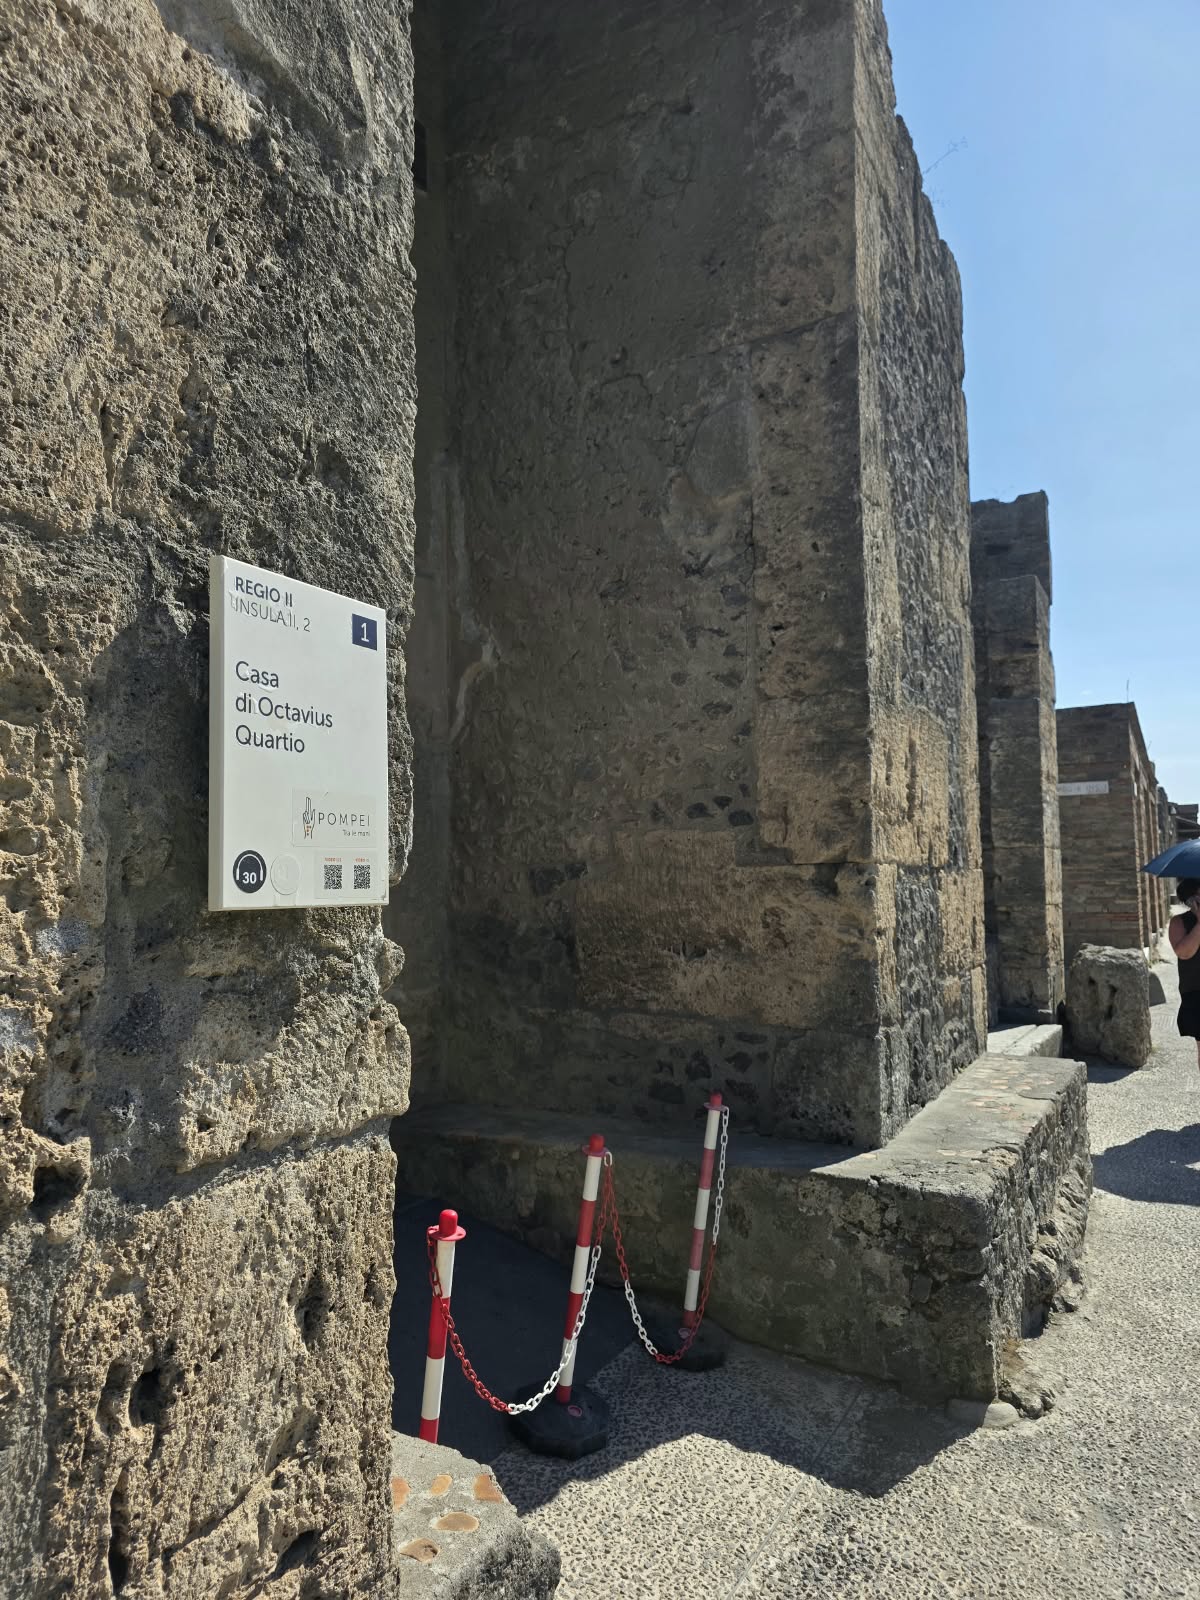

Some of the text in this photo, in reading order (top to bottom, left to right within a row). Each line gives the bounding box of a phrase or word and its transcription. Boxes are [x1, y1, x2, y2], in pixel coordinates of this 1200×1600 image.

[235, 576, 293, 607] REGIO II
[235, 596, 288, 627] INSULA
[303, 617, 311, 633] 2
[360, 622, 370, 643] 1
[235, 660, 279, 689] Casa
[235, 692, 334, 728] di Octavius
[235, 724, 305, 753] Quartio
[318, 811, 370, 827] POMPEI
[242, 871, 257, 884] 30
